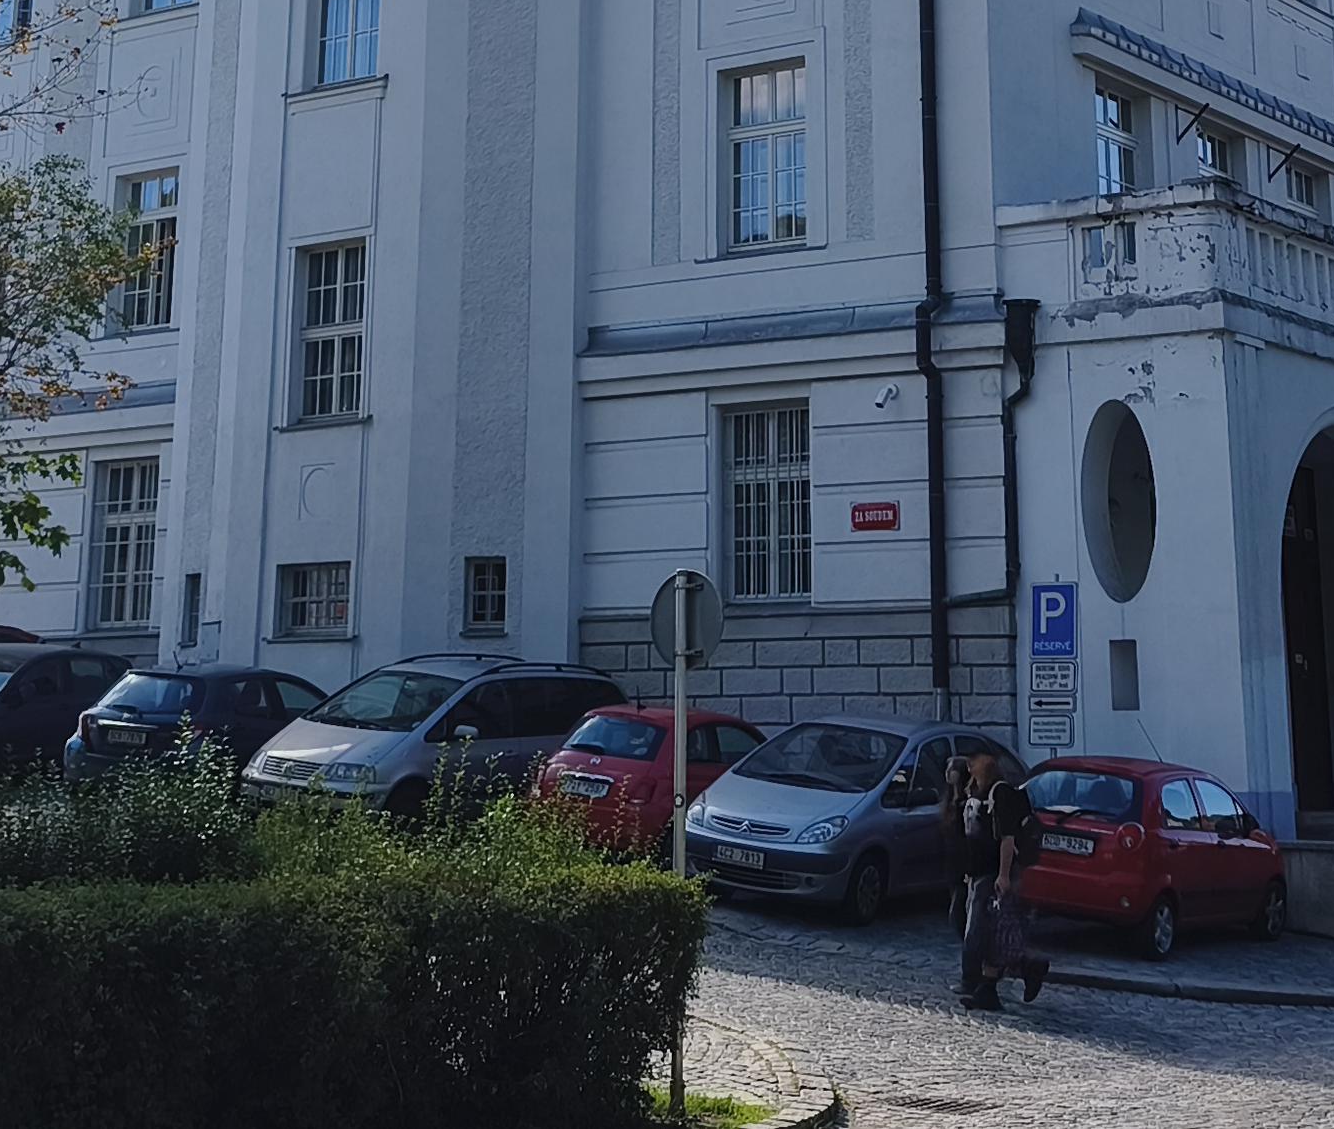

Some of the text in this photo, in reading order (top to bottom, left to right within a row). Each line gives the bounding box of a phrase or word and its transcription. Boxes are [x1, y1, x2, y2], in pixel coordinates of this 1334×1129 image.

[854, 509, 894, 523] ZA SOUDEM
[1040, 591, 1066, 634] P
